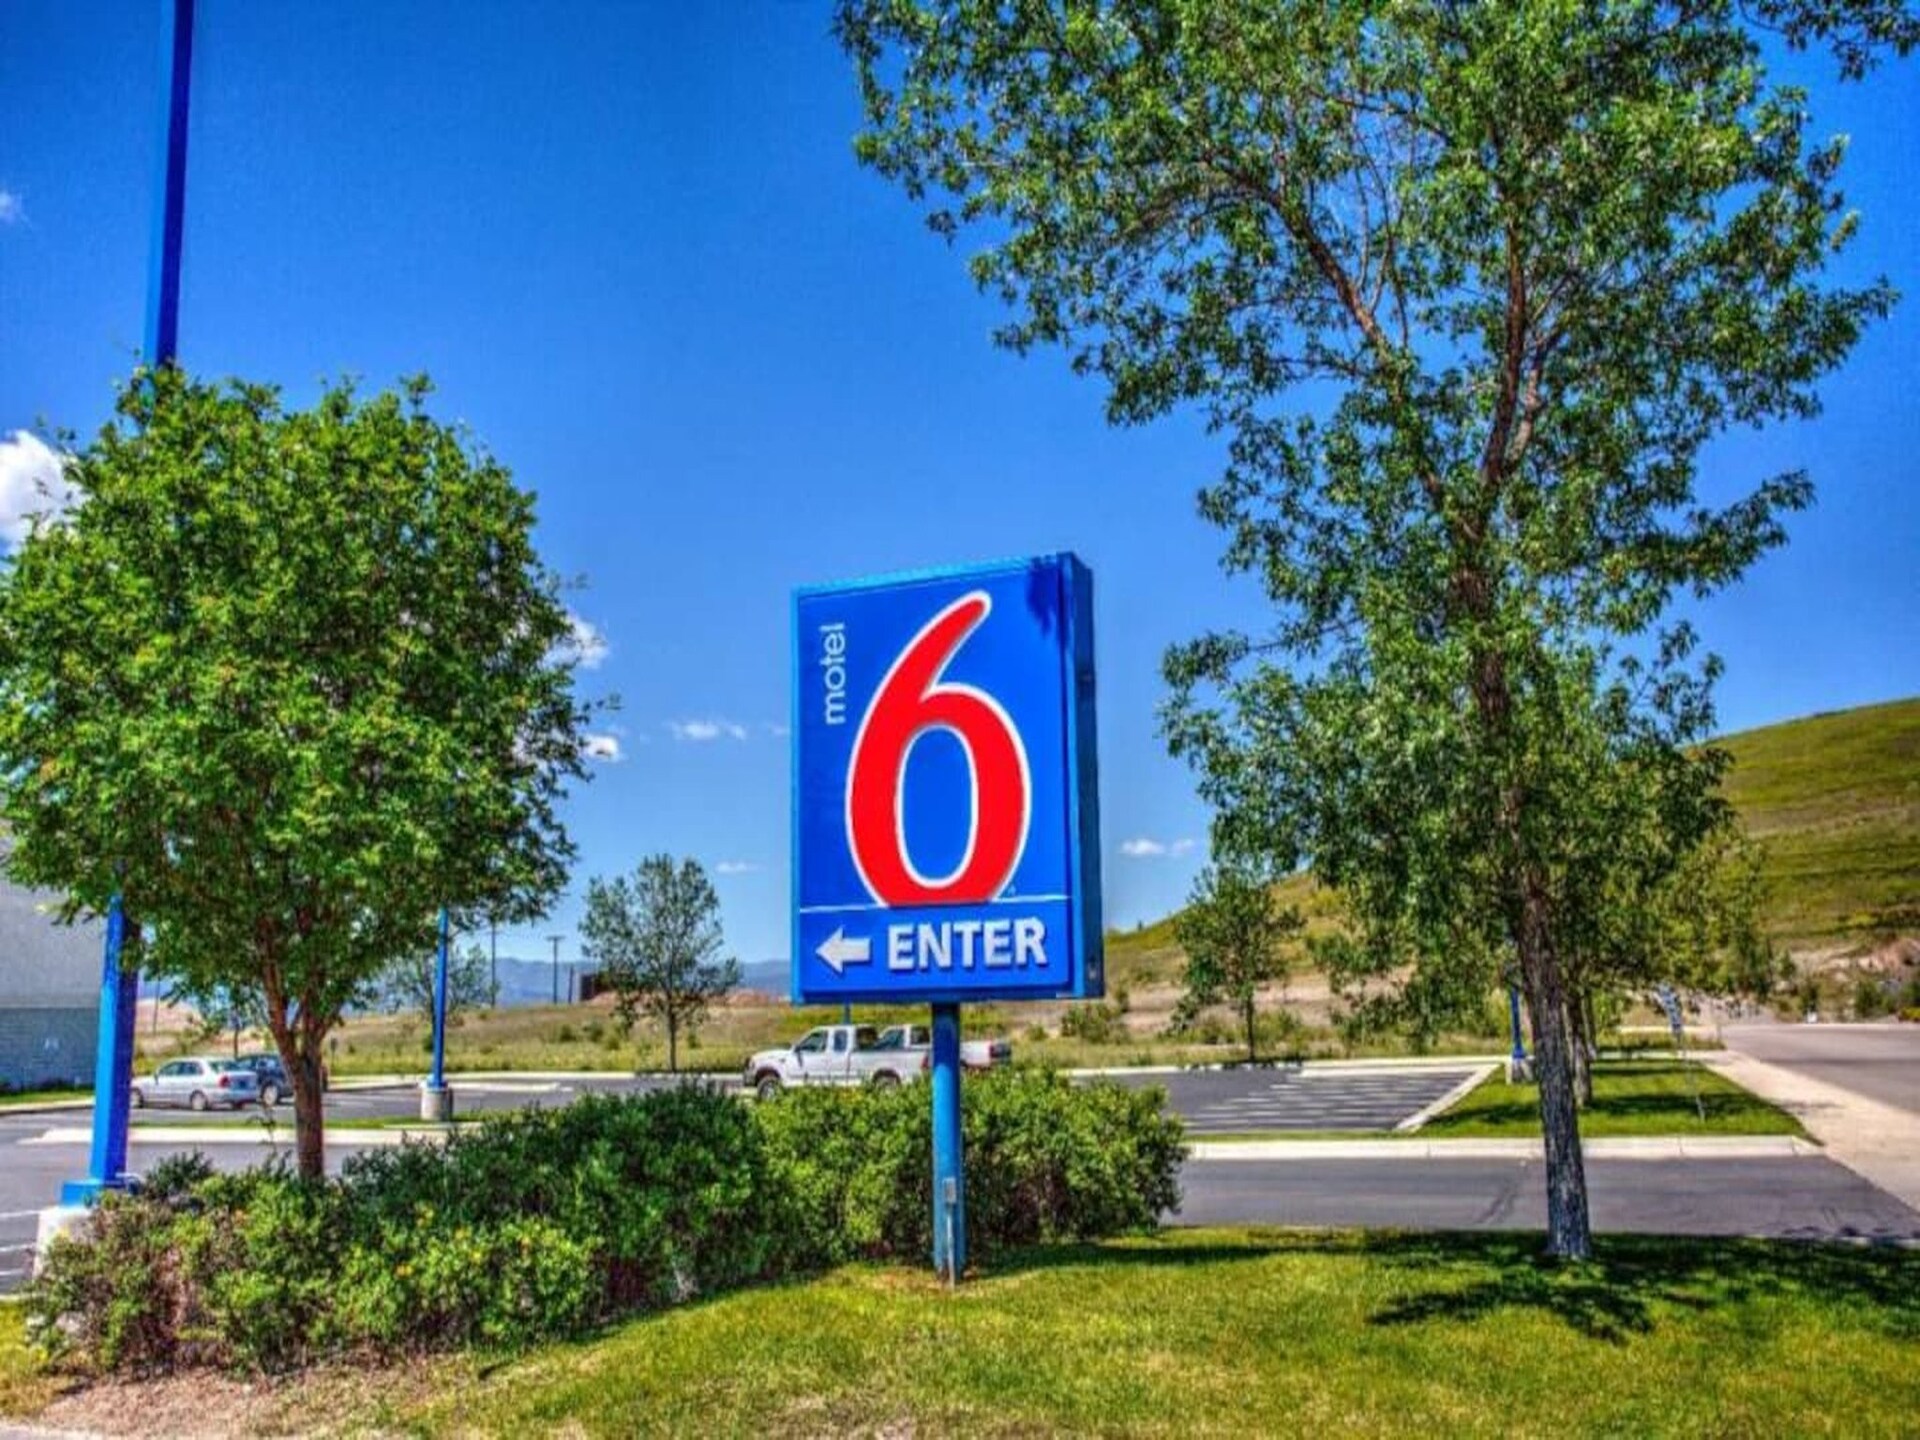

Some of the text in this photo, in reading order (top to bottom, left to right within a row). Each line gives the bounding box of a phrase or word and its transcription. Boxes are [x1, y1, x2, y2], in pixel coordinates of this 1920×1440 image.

[820, 622, 846, 725] motel
[845, 590, 1031, 907] 6
[887, 917, 1048, 971] ENTER
